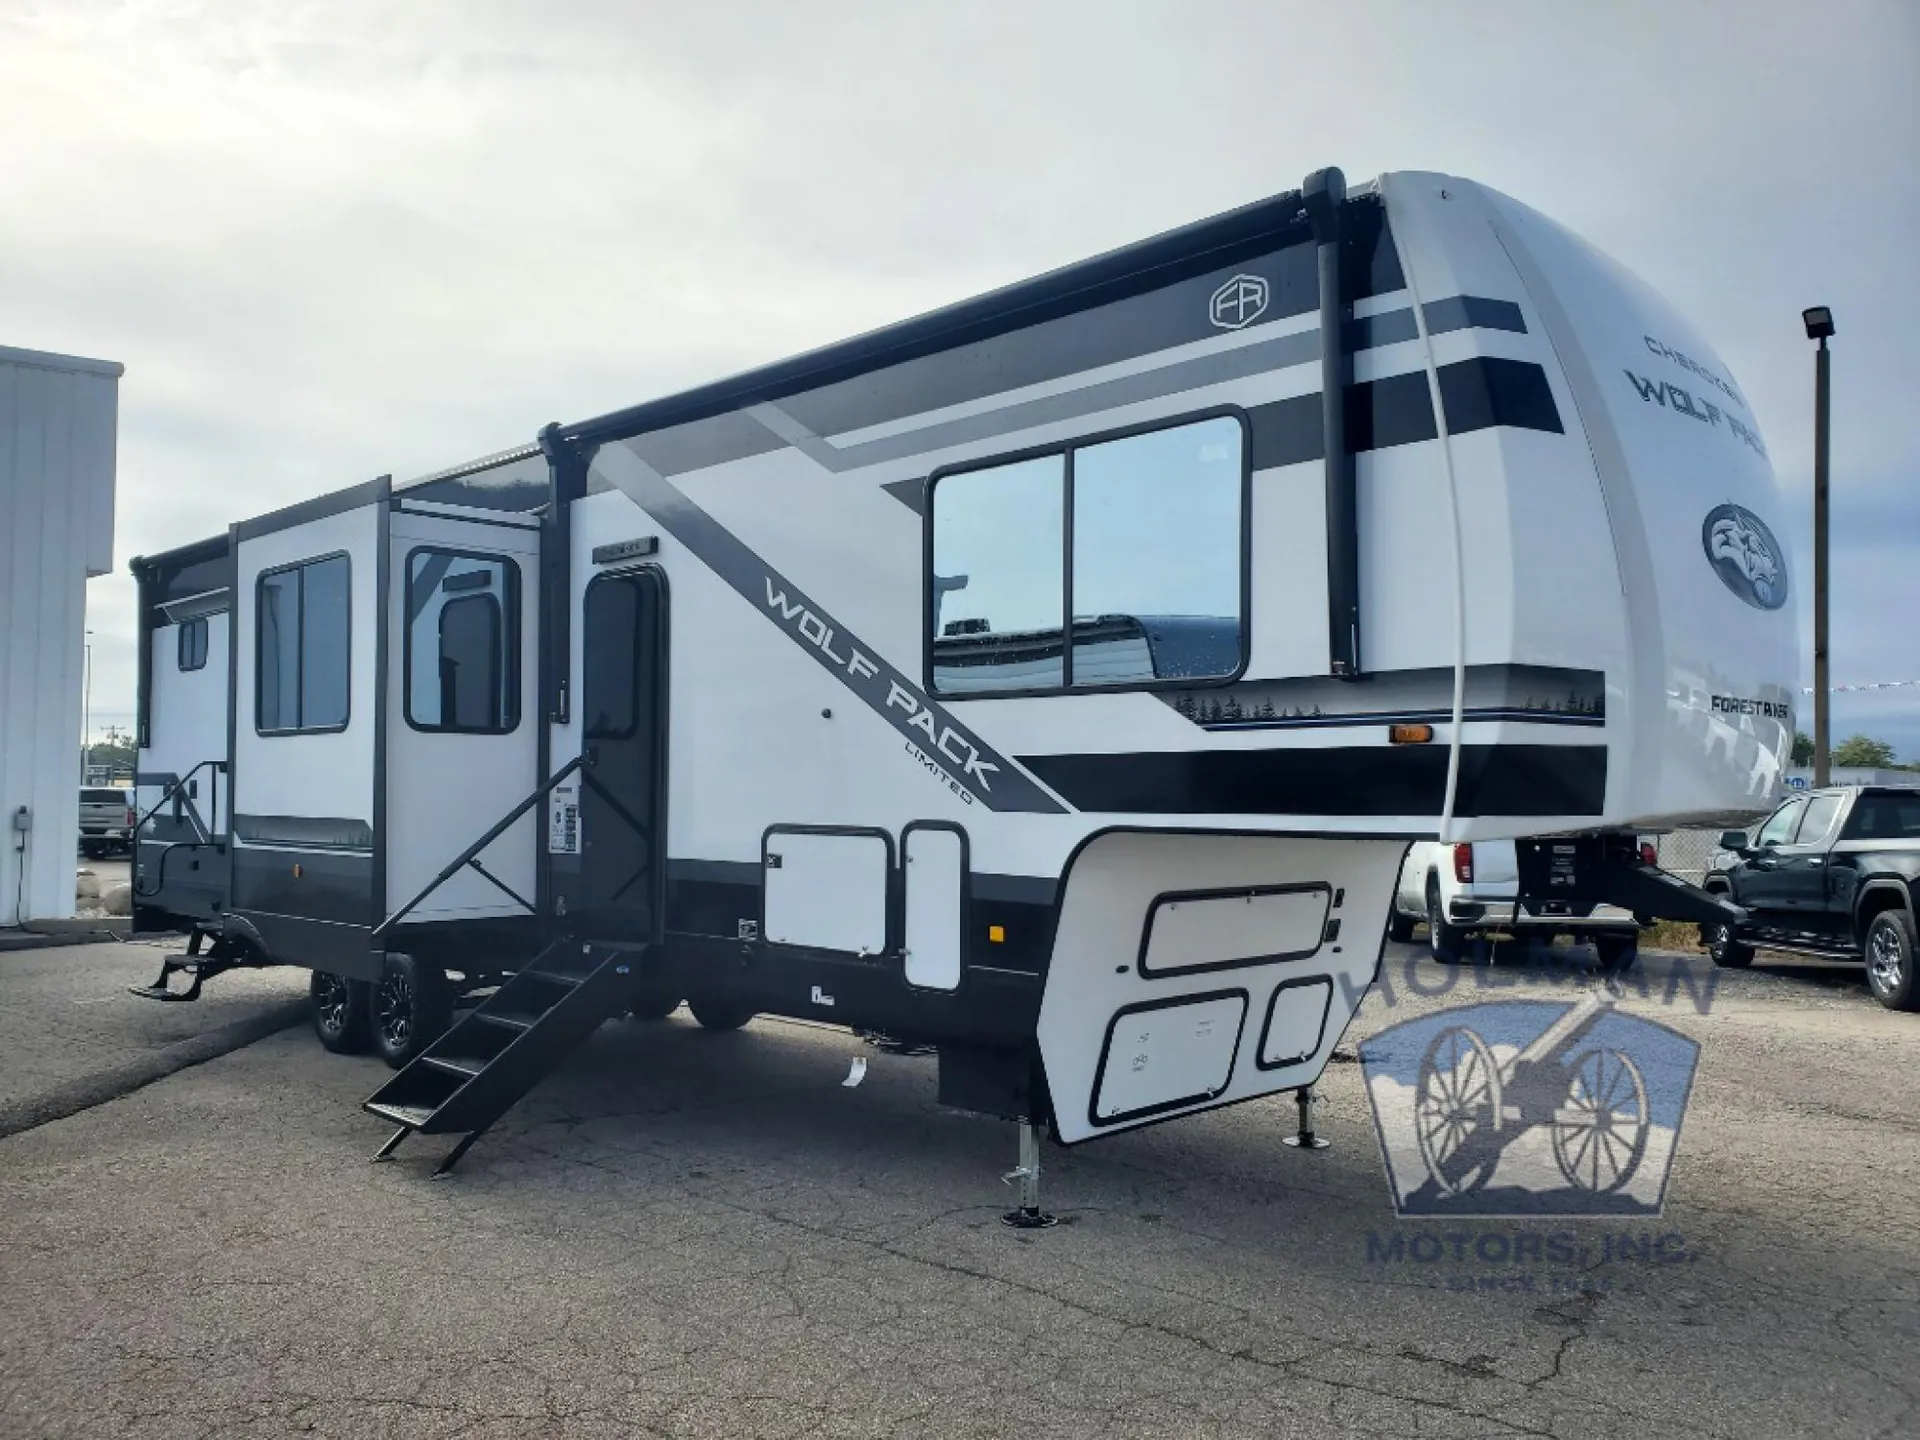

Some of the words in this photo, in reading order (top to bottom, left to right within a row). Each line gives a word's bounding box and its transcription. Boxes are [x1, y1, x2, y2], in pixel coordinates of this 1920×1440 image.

[1622, 369, 1721, 428] WOLF
[765, 576, 880, 680] WOLF
[886, 679, 1000, 793] PACK
[904, 741, 974, 805] LIMITED
